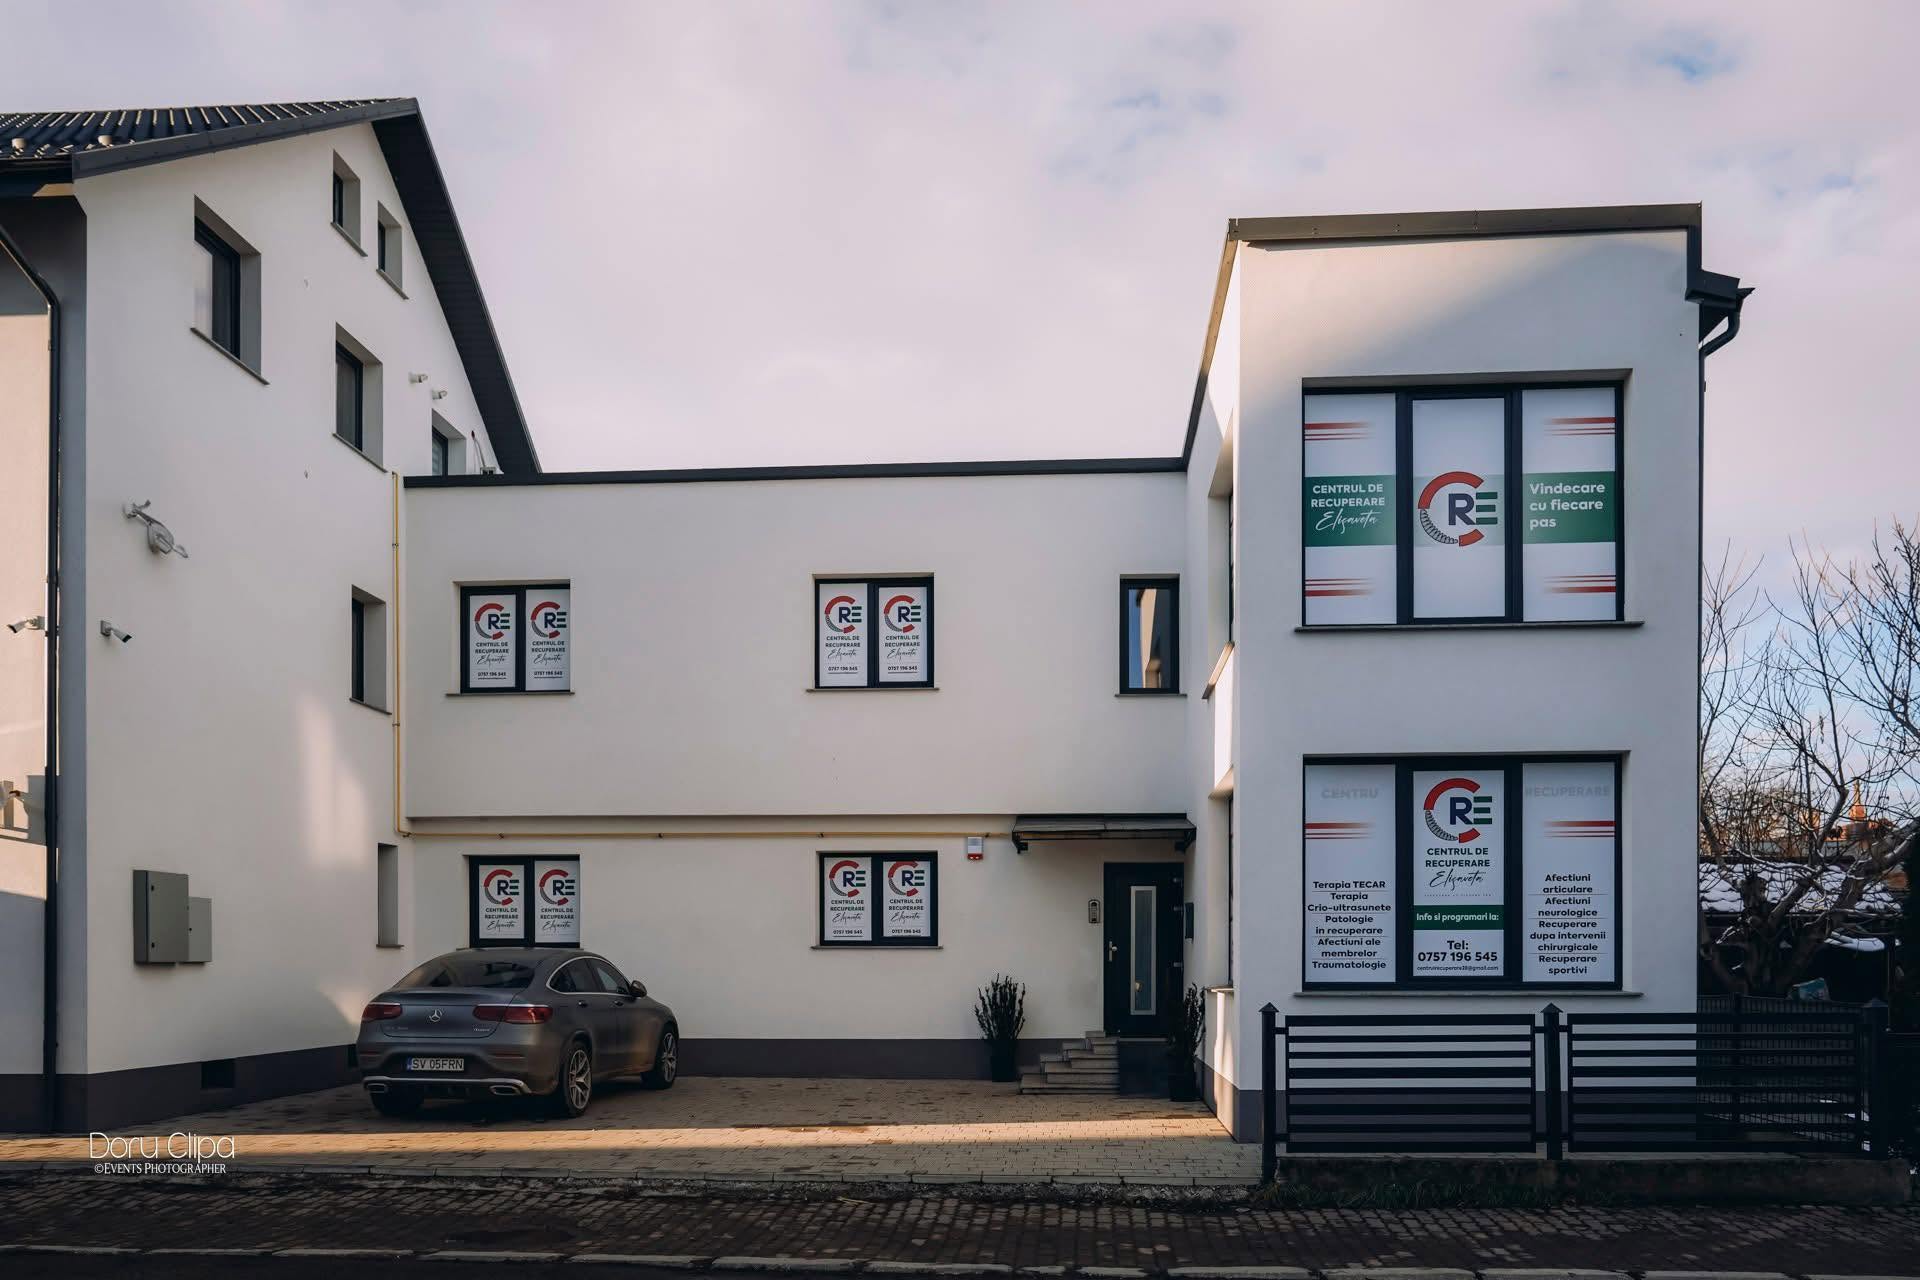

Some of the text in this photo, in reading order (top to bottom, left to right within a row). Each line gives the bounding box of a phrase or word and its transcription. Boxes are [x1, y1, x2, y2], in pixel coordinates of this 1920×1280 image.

[1313, 483, 1383, 494] CENTRUL DE
[1529, 482, 1605, 494] Vindecare
[1311, 497, 1385, 507] RECUPERARE
[1530, 499, 1603, 511] cu fiecare
[1530, 518, 1557, 530] pas
[1427, 847, 1489, 855] CENTRUL DE
[1425, 859, 1490, 867] RECUPERARE
[1313, 881, 1351, 890] Terapia
[1543, 885, 1593, 893] articulare
[1330, 892, 1368, 901] Terapia
[1416, 912, 1499, 923] Info si programari la:
[1538, 909, 1598, 918] neurologice
[1325, 915, 1374, 924] Patologie
[1538, 920, 1597, 929] Recuperare
[1529, 931, 1606, 940] dupa intervenii
[1447, 940, 1469, 950] Tel:
[1537, 943, 1598, 952] chirurgicale
[1321, 949, 1378, 957] membrelor
[1417, 952, 1498, 961] 0757 196 545
[1538, 955, 1597, 964] Recuperare
[1312, 961, 1387, 970] Traumatologie
[1548, 966, 1588, 975] sportivi
[412, 1059, 426, 1069] SV
